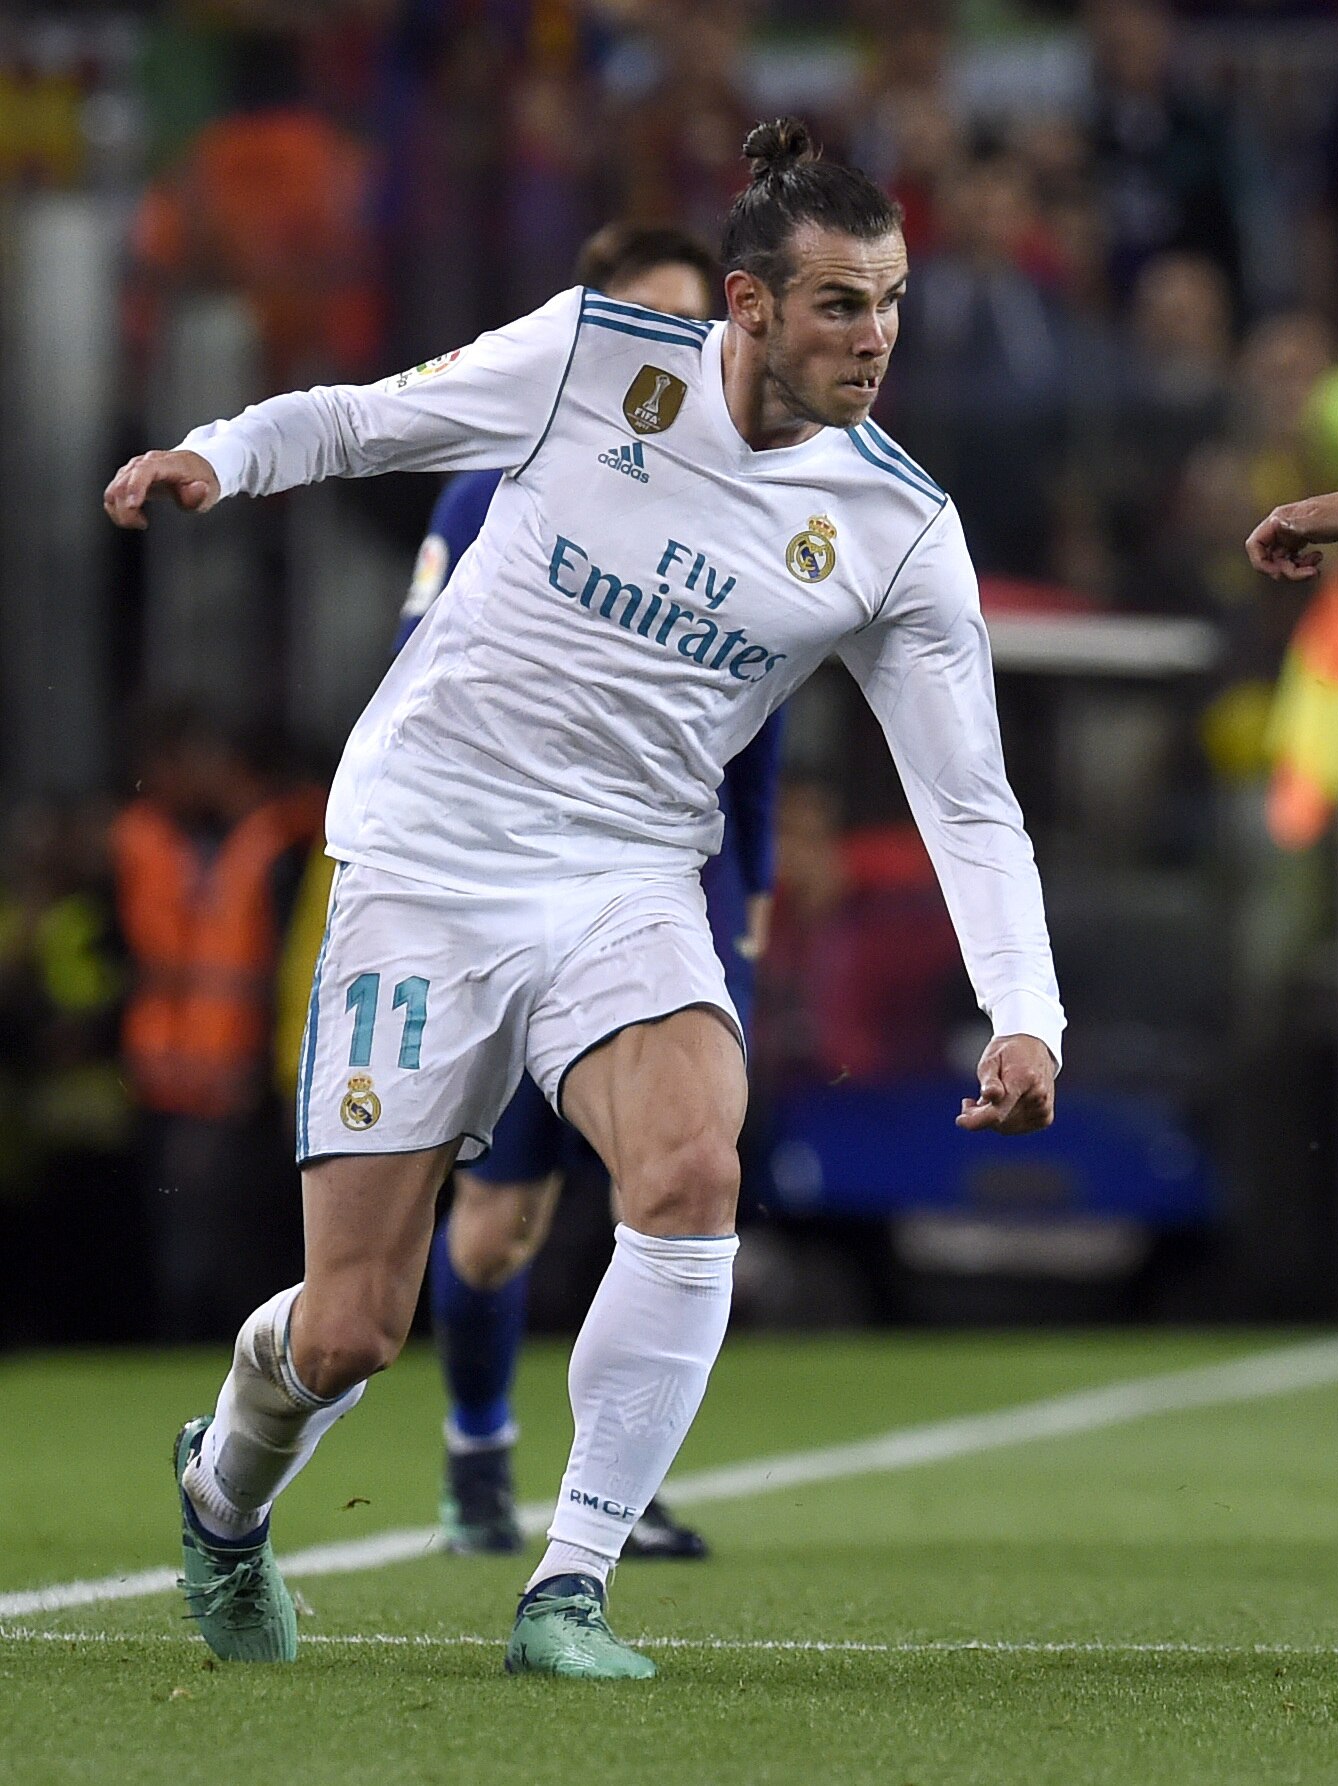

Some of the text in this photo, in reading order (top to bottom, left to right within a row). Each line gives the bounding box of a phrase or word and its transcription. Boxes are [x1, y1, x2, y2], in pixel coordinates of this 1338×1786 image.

[634, 407, 658, 424] FIFA
[598, 453, 650, 483] adidas
[656, 539, 737, 609] Fly
[548, 534, 787, 682] Emirates
[345, 973, 430, 1070] 11
[570, 1489, 637, 1518] RMCF
